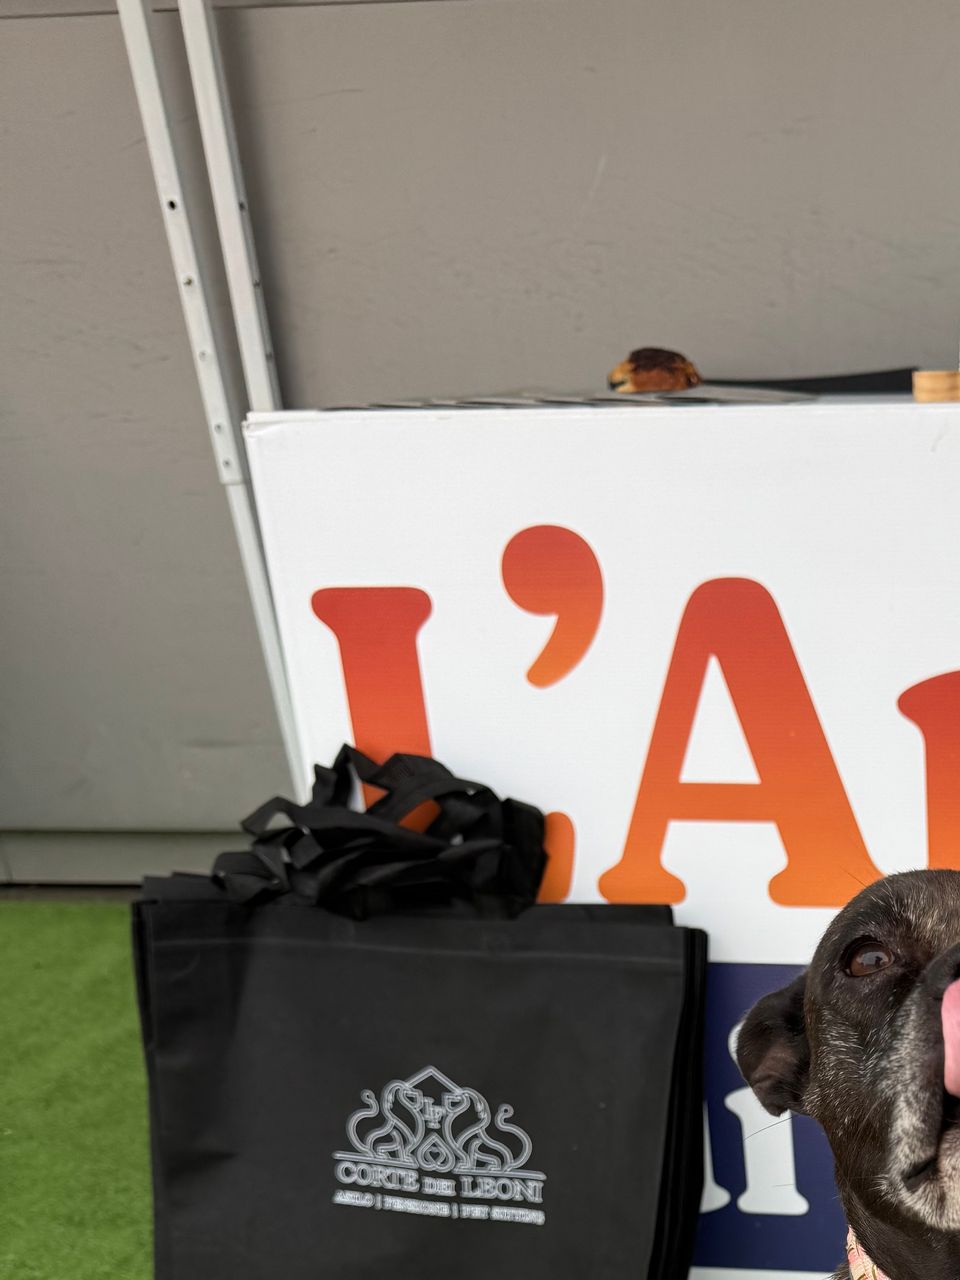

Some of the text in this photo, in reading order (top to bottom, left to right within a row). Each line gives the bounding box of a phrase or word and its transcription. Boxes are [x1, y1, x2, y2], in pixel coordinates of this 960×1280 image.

[335, 1162, 543, 1203] CORTE DEI LEONI
